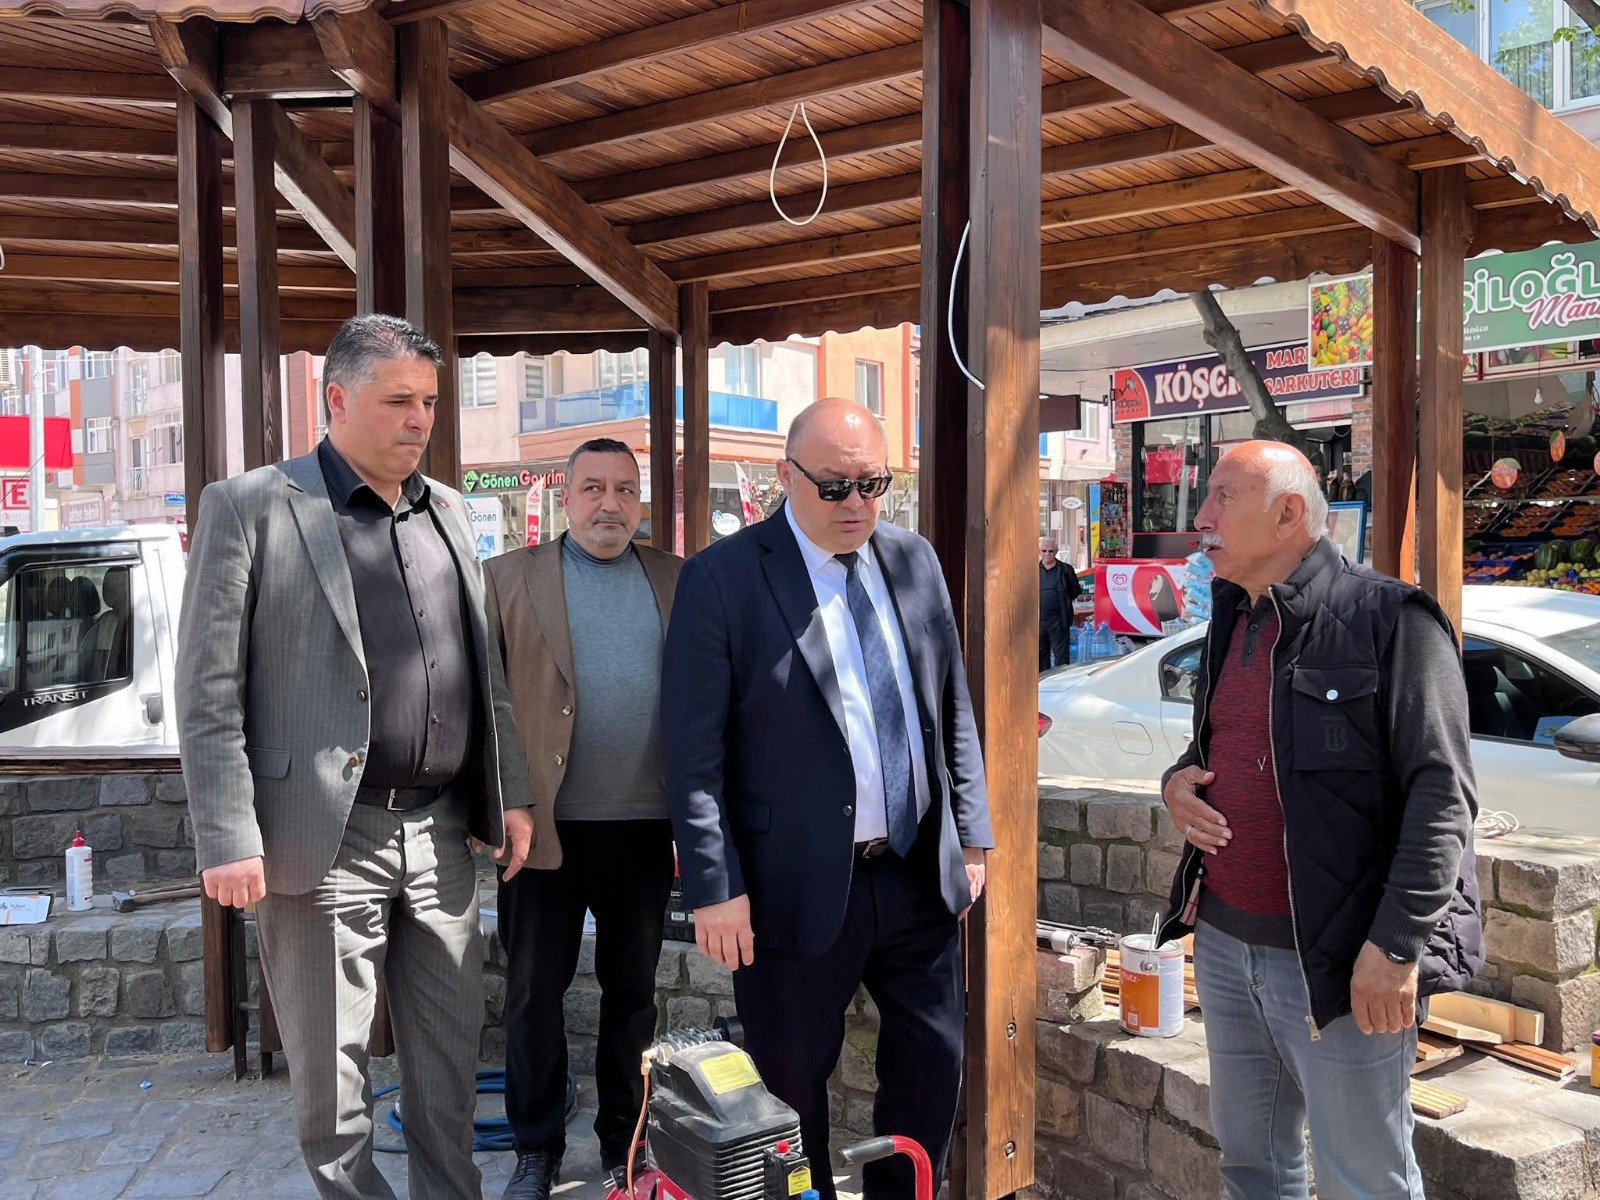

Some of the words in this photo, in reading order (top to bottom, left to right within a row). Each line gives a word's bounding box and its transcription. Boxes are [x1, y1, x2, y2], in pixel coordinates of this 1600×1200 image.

[1521, 292, 1600, 330] Man
[1266, 345, 1308, 370] MAR
[479, 472, 519, 489] Gönen
[12, 484, 27, 505] E
[23, 690, 88, 706] TRANSIT
